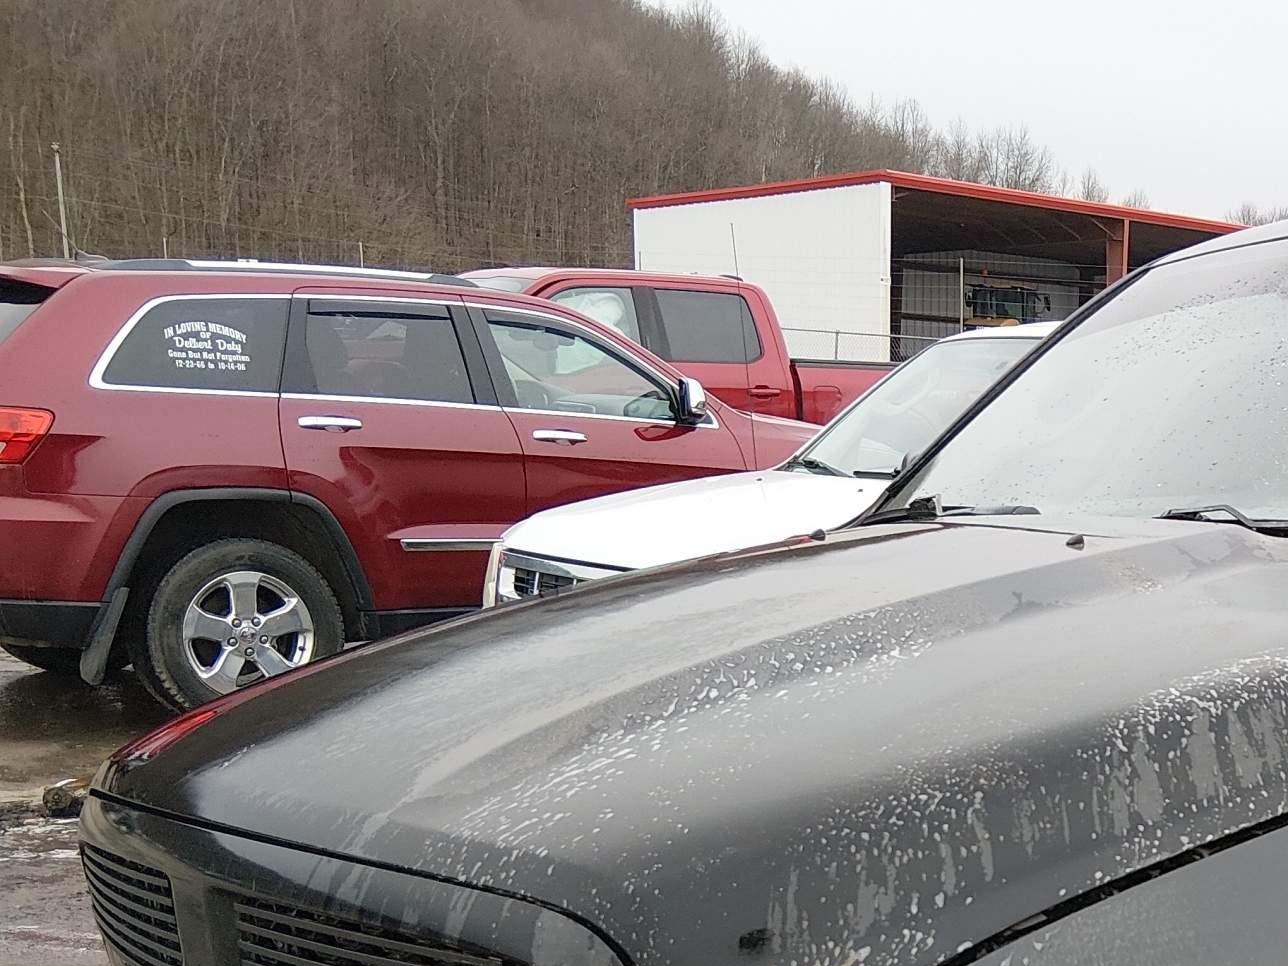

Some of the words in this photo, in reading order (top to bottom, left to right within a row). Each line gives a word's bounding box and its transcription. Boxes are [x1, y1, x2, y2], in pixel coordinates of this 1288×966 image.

[164, 327, 173, 338] IN
[175, 322, 206, 334] LOVING
[208, 323, 246, 343] MEMORY
[168, 350, 186, 358] Gone
[216, 352, 250, 361] Forgotten
